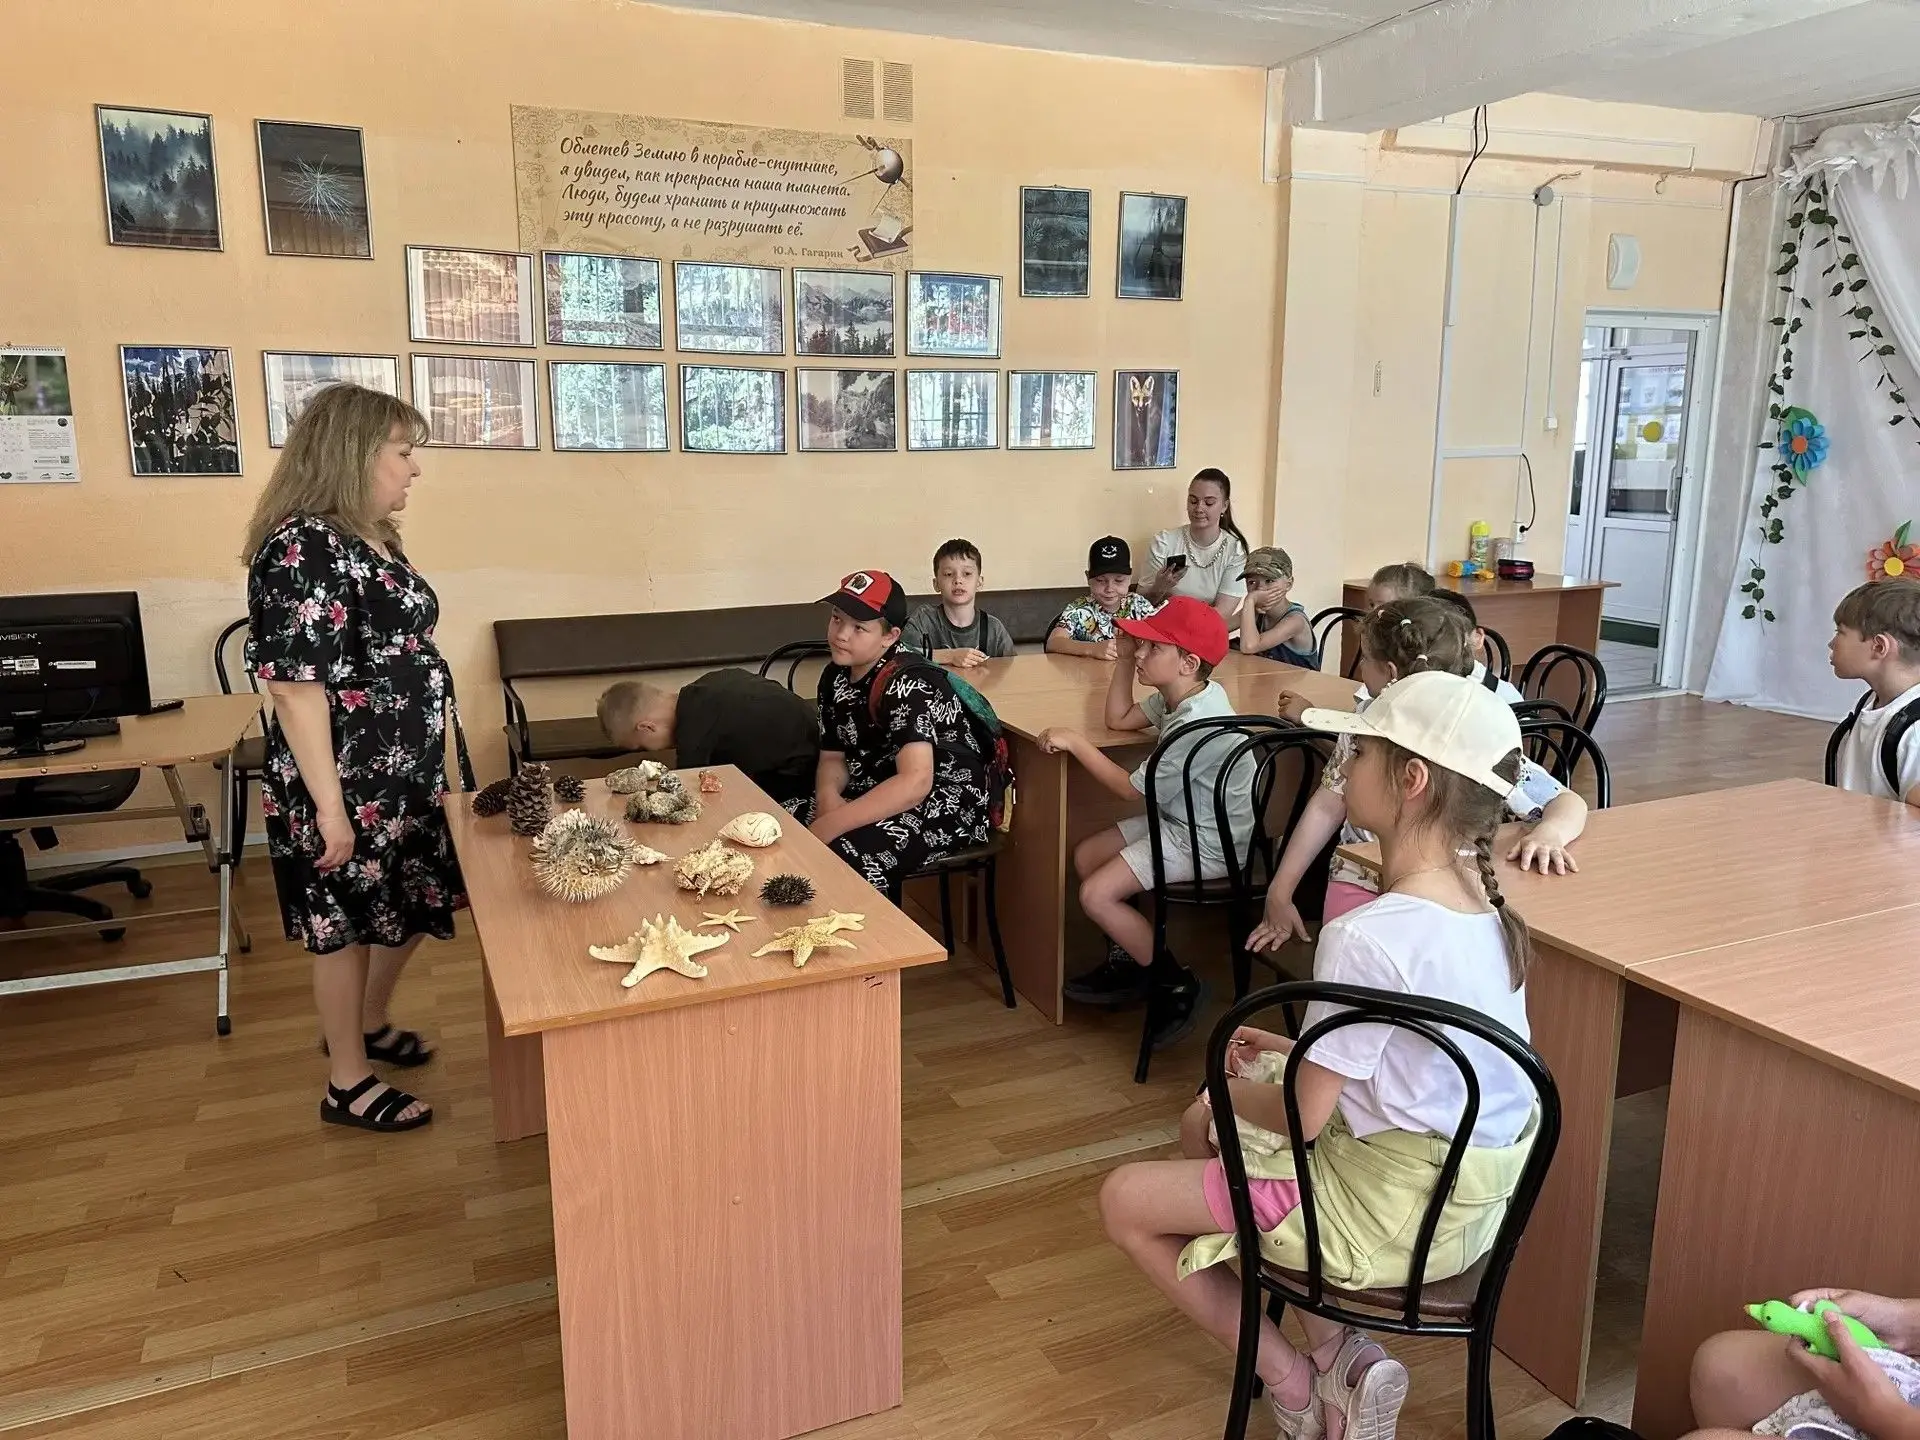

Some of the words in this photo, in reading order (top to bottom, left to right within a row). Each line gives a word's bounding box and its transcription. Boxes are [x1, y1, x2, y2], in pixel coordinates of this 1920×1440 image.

[560, 136, 630, 158] Облетев
[633, 142, 687, 162] Землю
[690, 146, 699, 163] в
[702, 150, 838, 177] корабле-спутнике,
[560, 165, 570, 176] я
[572, 160, 631, 184] увидел,
[635, 169, 661, 182] как
[664, 171, 740, 191] прекрасна
[744, 178, 782, 192] наша
[785, 181, 851, 197] планета.
[561, 183, 610, 207] Люди,
[614, 184, 661, 210] будем
[664, 193, 728, 212] хранить
[731, 199, 740, 210] и
[743, 199, 847, 219] приумножать
[563, 210, 595, 229] эту
[597, 211, 666, 233] красоту,
[671, 217, 679, 228] а
[683, 218, 701, 230] не
[703, 218, 783, 238] разрушать
[787, 222, 804, 236] её.
[773, 246, 798, 256] Ю.А.
[801, 248, 844, 259] Гагарин
